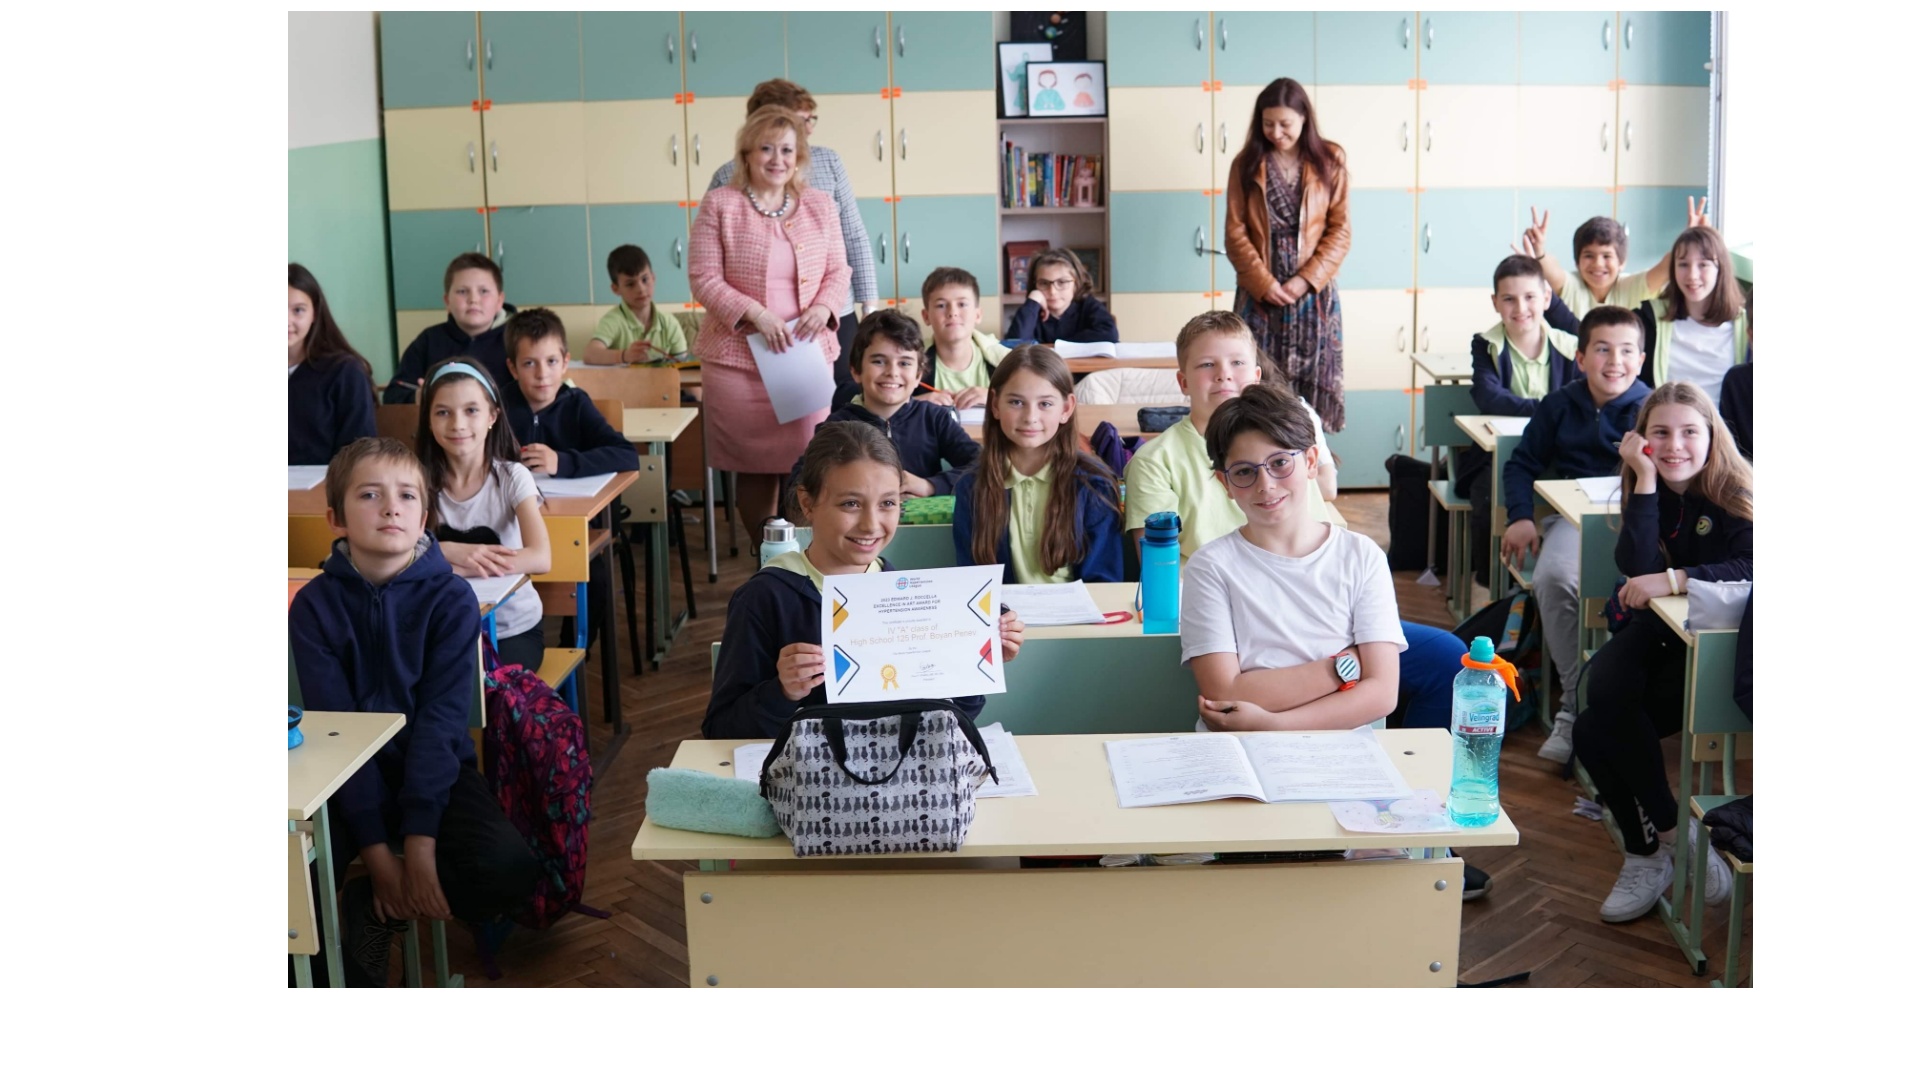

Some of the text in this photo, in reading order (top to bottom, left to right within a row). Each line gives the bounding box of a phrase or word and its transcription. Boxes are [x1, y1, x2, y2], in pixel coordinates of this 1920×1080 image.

[910, 624, 929, 632] class
[930, 623, 938, 631] of
[850, 638, 867, 647] High
[869, 636, 894, 645] School
[896, 634, 909, 643] 125
[930, 631, 953, 640] Boyan
[954, 629, 977, 637] Penev
[1469, 712, 1499, 722] Velingrad
